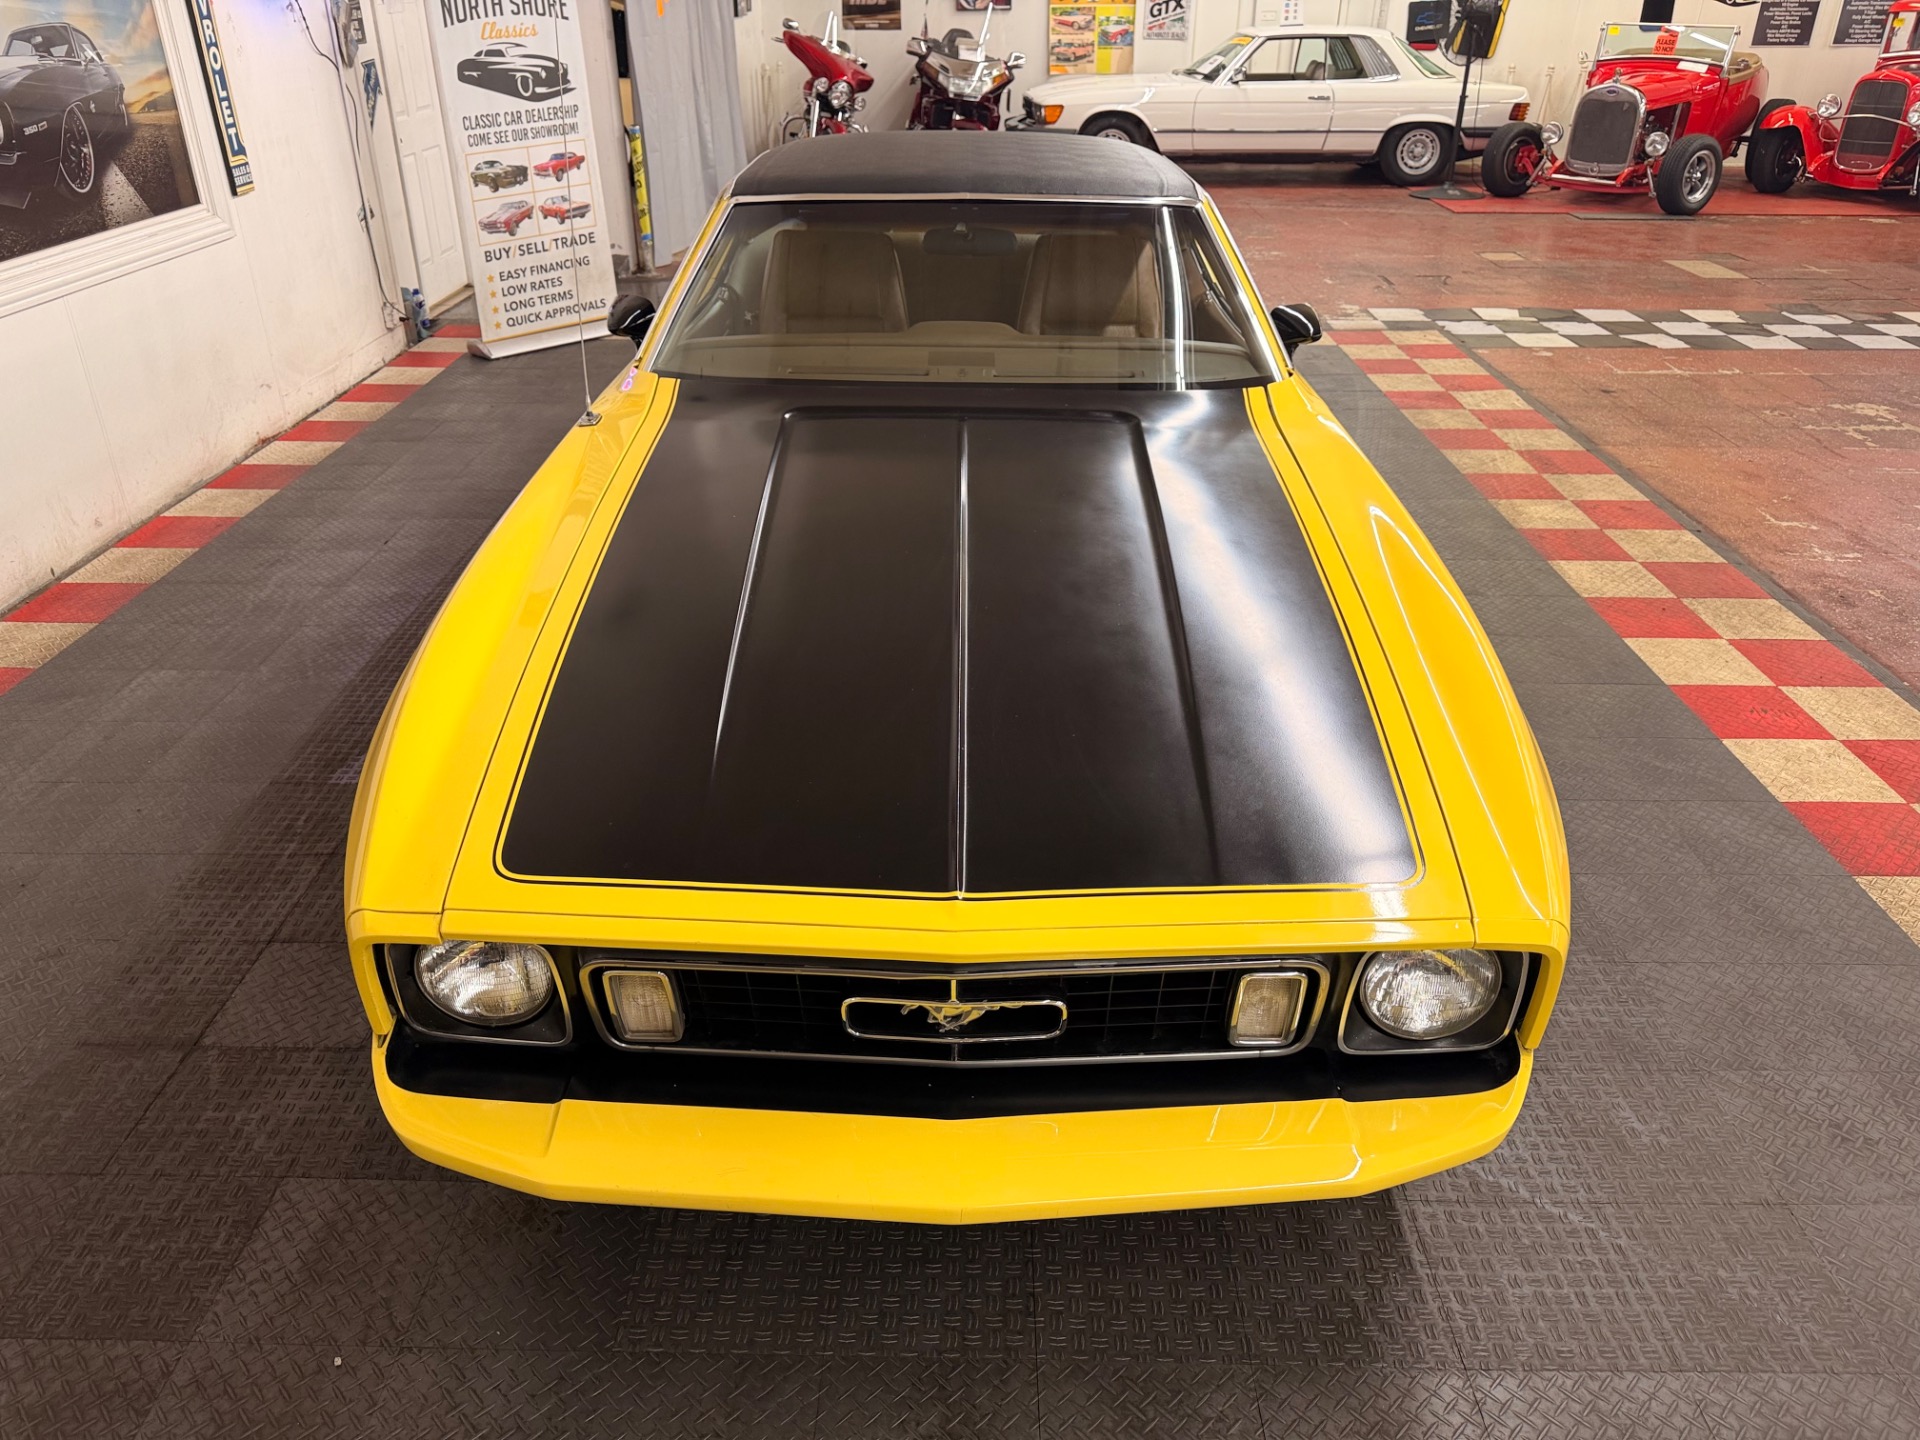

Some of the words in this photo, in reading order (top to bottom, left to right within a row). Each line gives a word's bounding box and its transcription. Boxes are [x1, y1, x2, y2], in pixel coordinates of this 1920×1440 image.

[1149, 0, 1185, 18] GTX
[480, 21, 538, 40] Classics
[462, 112, 501, 131] CLASSIC
[504, 110, 524, 126] CAR
[525, 104, 579, 124] DEALERSHIP
[467, 131, 497, 148] COME
[494, 129, 510, 145] SEE
[511, 126, 530, 142] OUR
[531, 122, 579, 140] SHOWROOM!
[232, 166, 247, 178] SALES
[498, 267, 528, 282] EASY
[530, 255, 590, 277] FINANCING
[501, 284, 529, 298] LOW
[530, 276, 563, 292] RATES
[503, 298, 536, 313] LONG
[537, 290, 574, 306] TERMS
[506, 312, 543, 328] QUICK
[545, 298, 607, 320] APPROVALS
